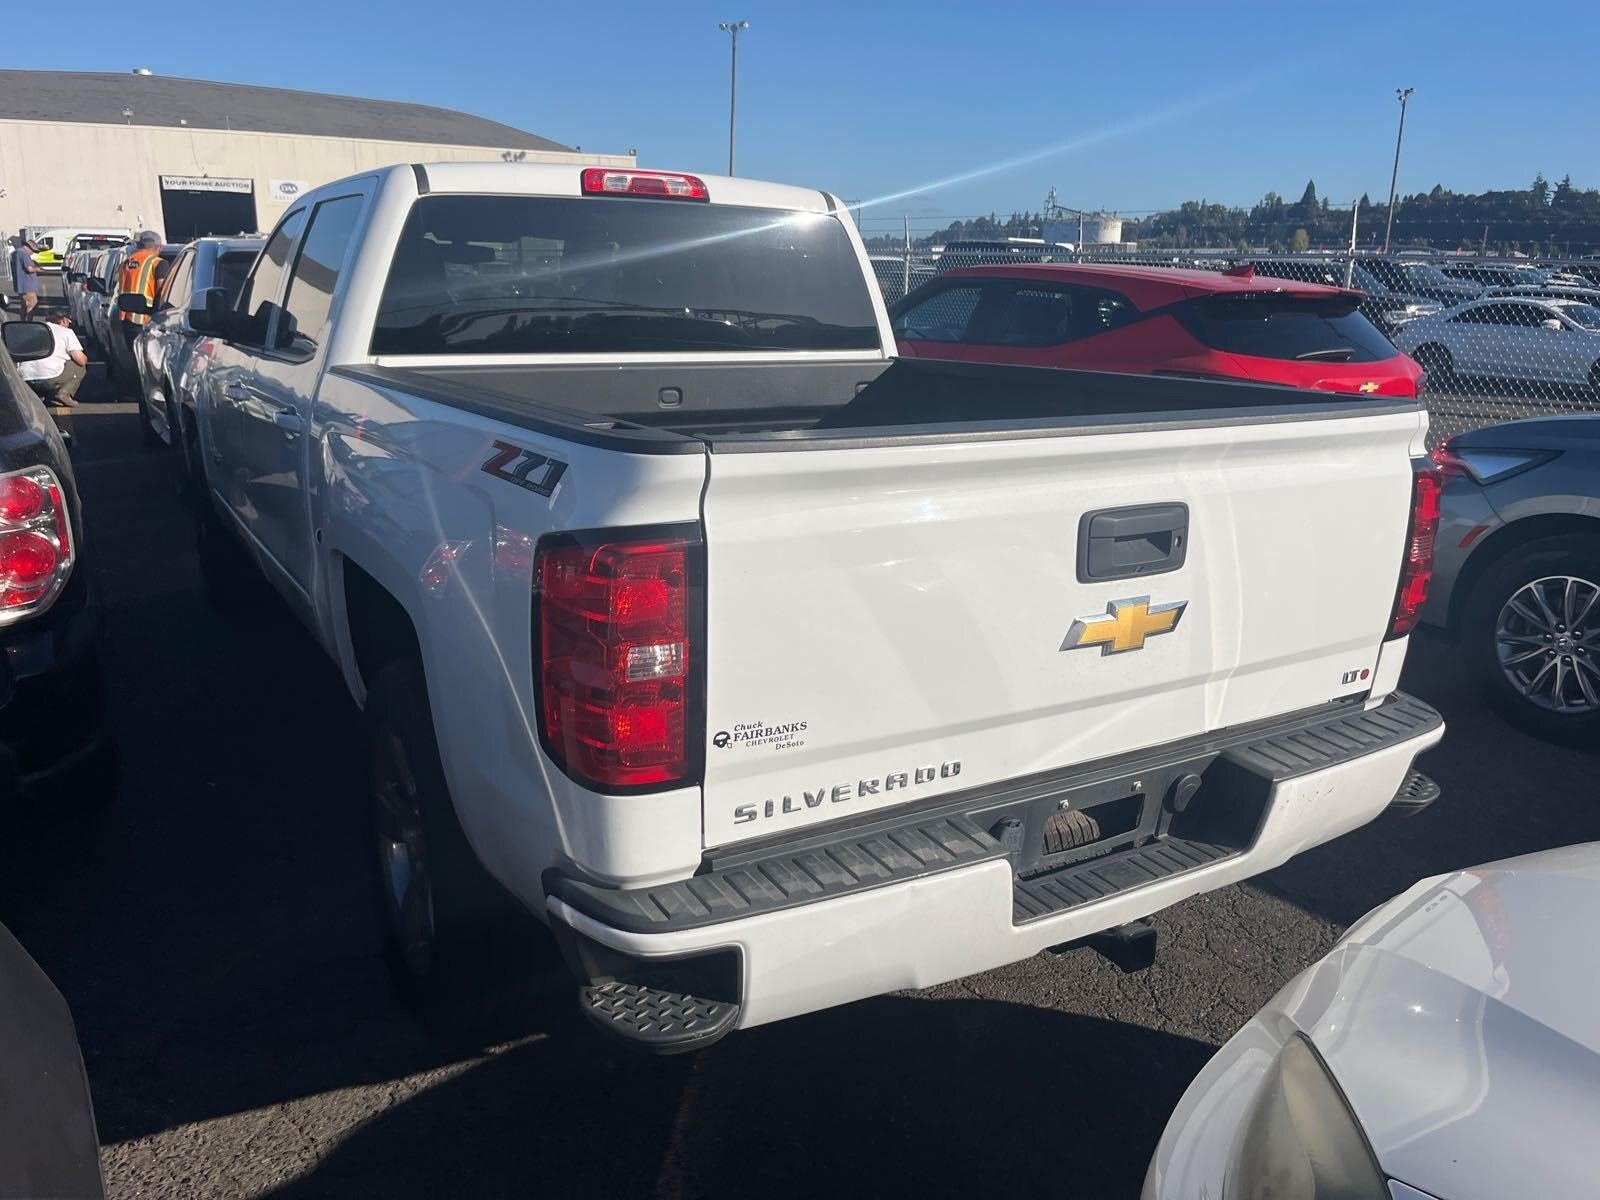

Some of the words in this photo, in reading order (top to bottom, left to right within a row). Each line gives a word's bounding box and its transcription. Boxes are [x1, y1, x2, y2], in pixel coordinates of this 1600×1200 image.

[481, 440, 568, 494] Z71
[1342, 670, 1360, 684] LT
[733, 721, 808, 742] FAIRBANKS
[734, 721, 763, 732] Chuck
[745, 734, 794, 747] CHEVROLET
[775, 740, 804, 750] DeSoto
[734, 760, 961, 824] SILVERADO
